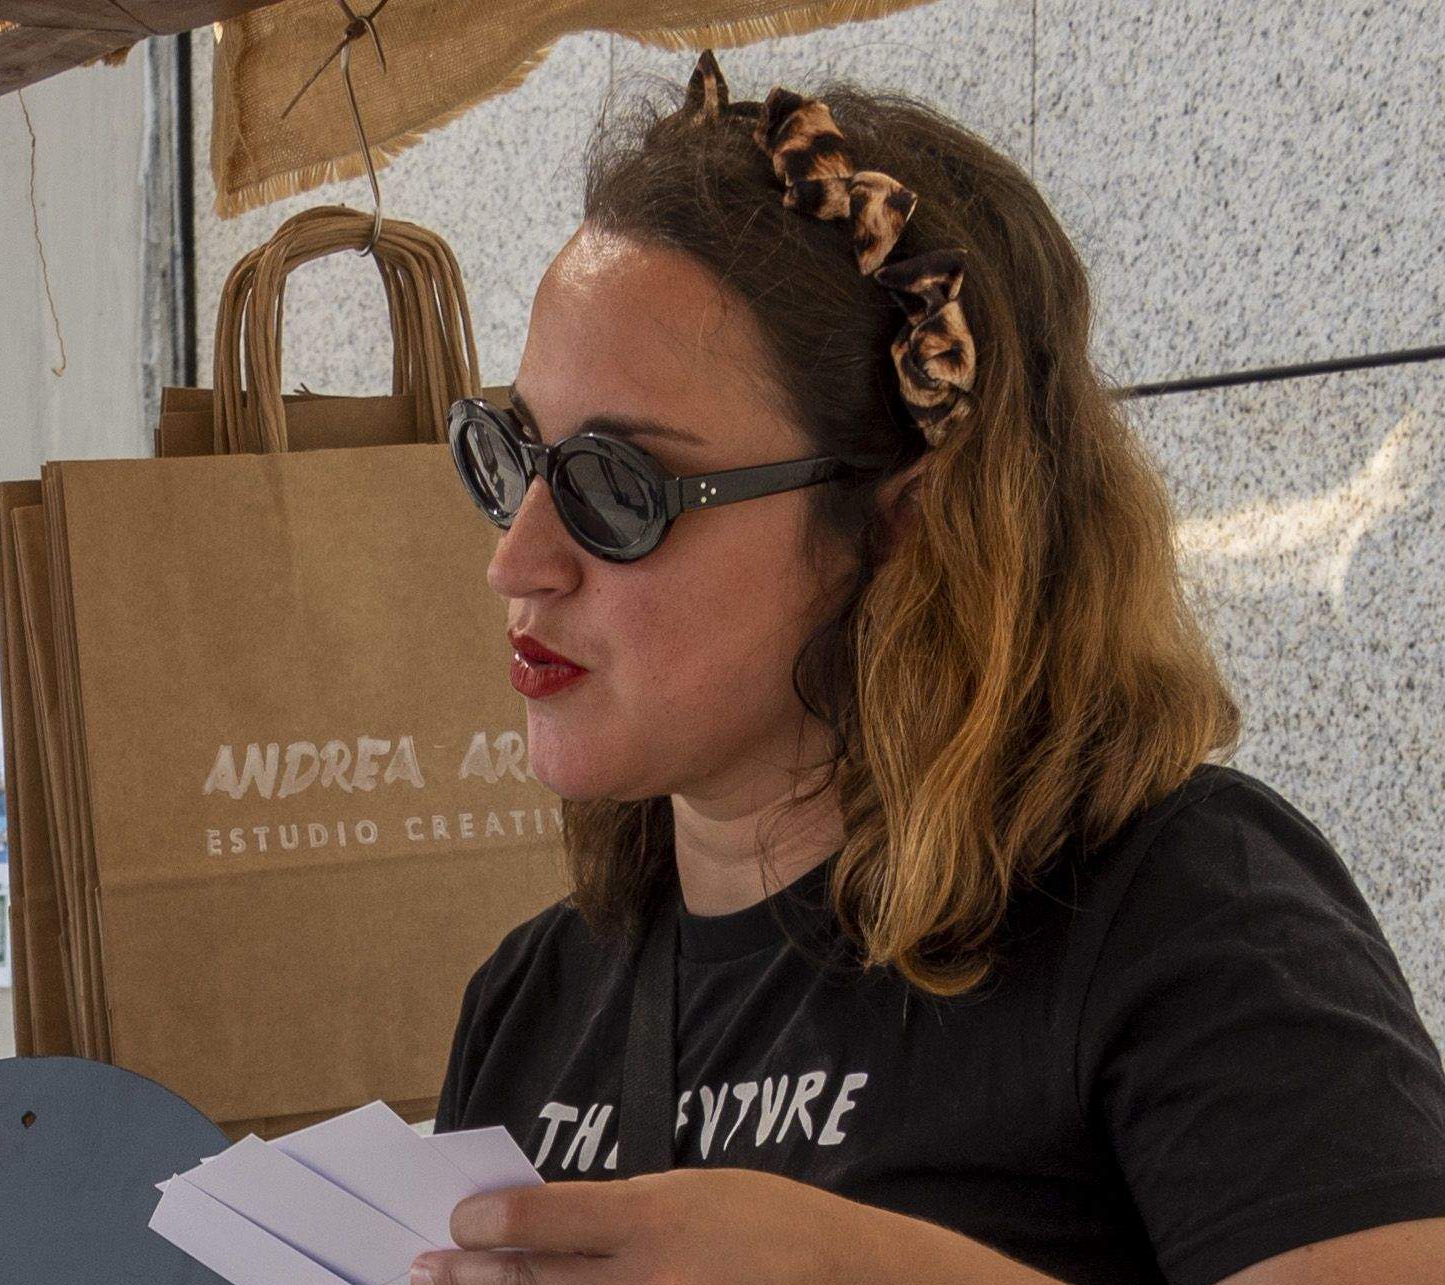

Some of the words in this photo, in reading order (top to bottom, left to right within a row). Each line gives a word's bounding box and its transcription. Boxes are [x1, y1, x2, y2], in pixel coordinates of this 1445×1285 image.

[203, 735, 425, 799] ANDREA
[459, 731, 537, 783] AR
[205, 819, 379, 856] ESTUDIO
[405, 807, 563, 842] CREATIV
[534, 1101, 619, 1172] TH
